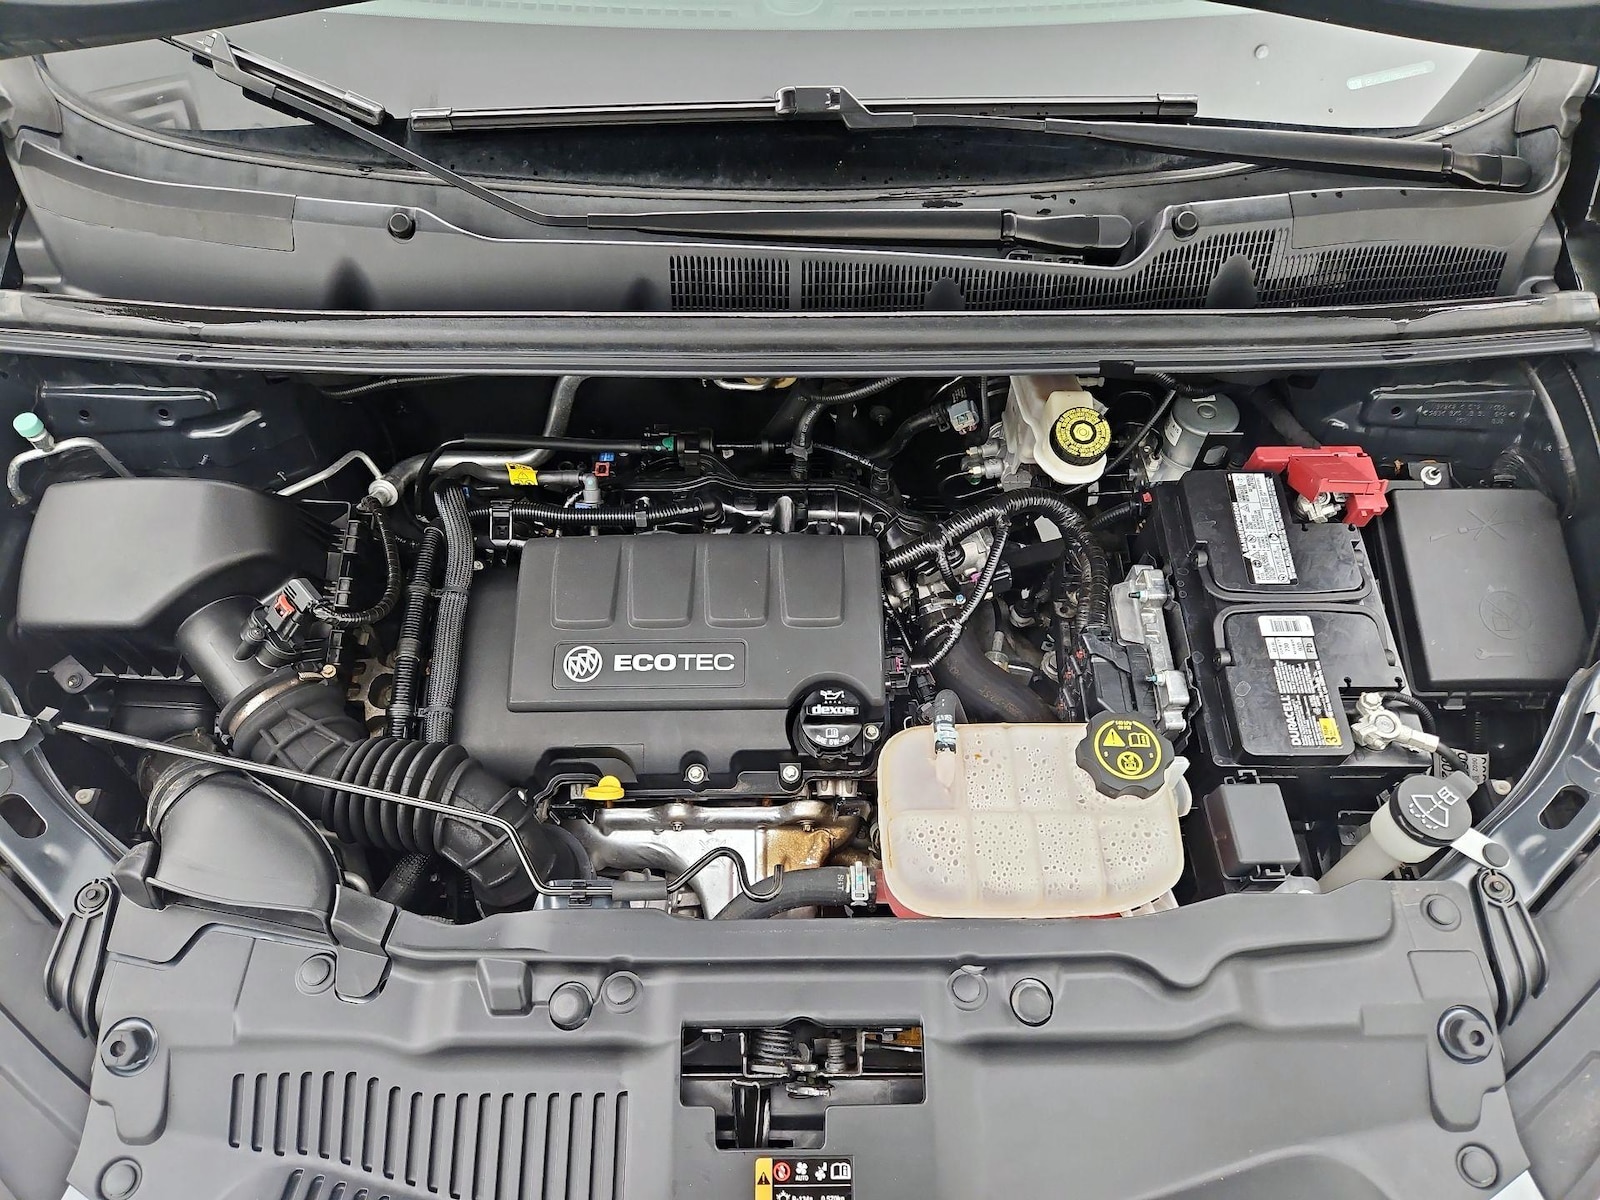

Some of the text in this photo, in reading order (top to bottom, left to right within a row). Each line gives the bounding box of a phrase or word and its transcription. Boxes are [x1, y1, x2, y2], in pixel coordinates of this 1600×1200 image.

[614, 653, 735, 672] ECOTEC
[811, 704, 856, 715] dexos
[1281, 696, 1302, 745] DURACELL
